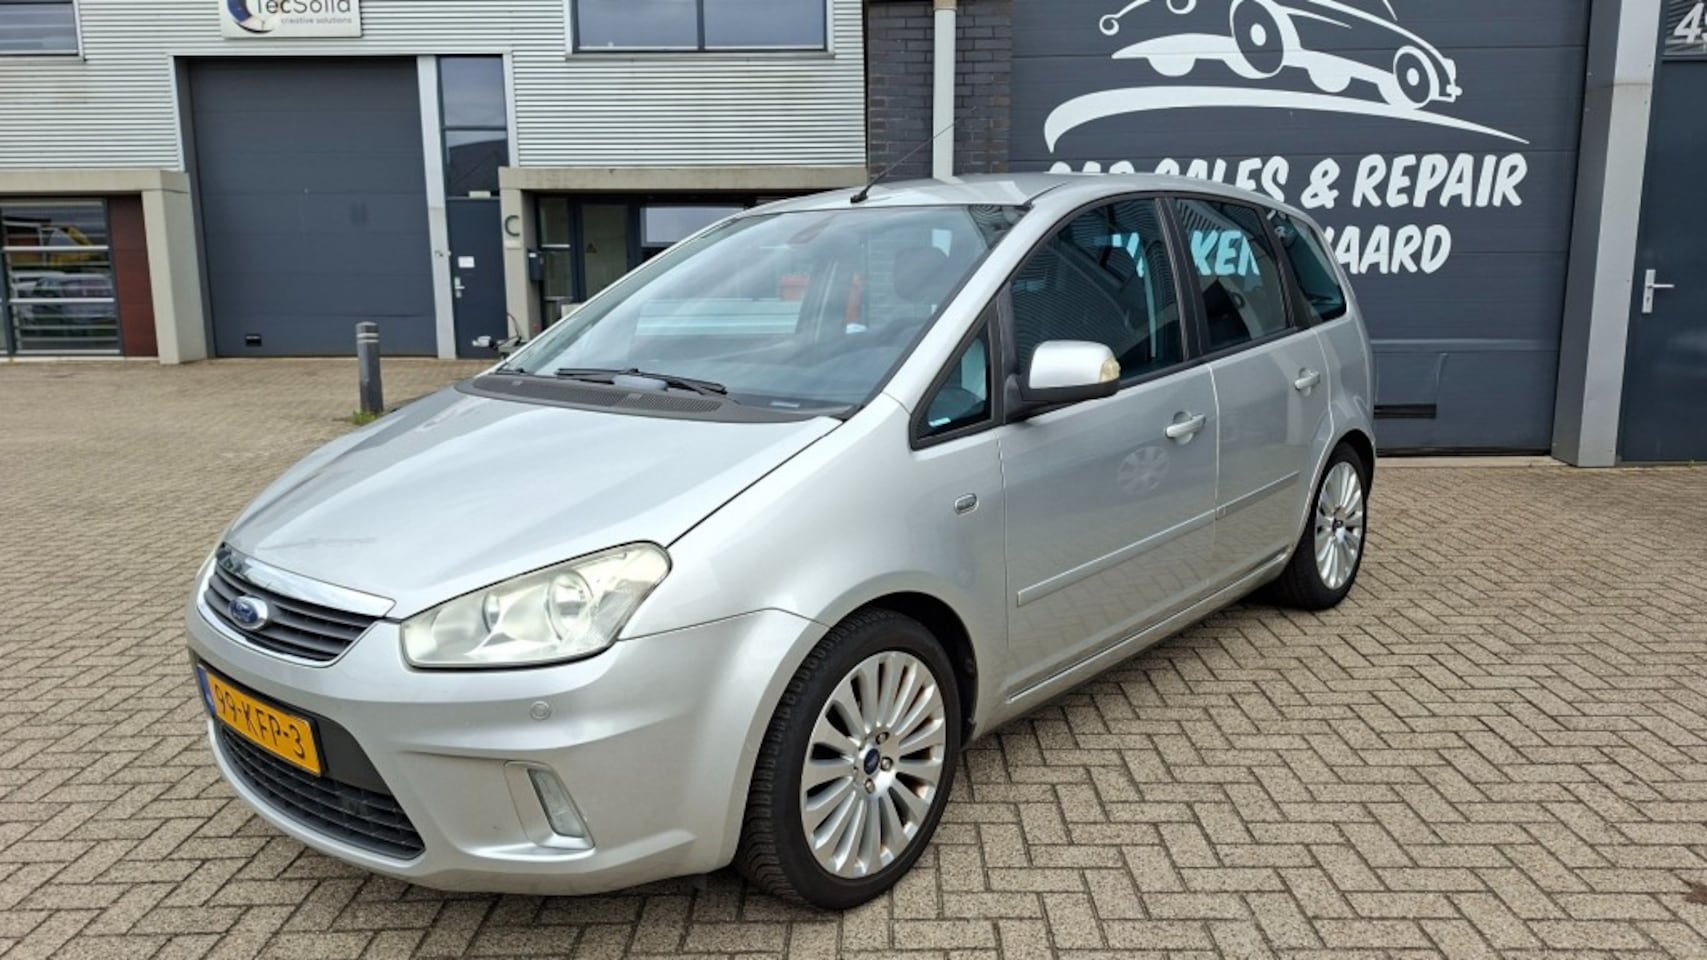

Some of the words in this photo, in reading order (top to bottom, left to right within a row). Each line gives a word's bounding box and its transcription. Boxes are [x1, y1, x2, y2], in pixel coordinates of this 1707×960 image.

[316, 16, 352, 24] solutions
[1673, 2, 1707, 43] 4
[1301, 158, 1340, 209] &
[1352, 153, 1527, 208] REPAIR
[504, 214, 520, 237] C
[1324, 224, 1451, 274] AARD
[214, 683, 306, 760] 99-KFP-3
